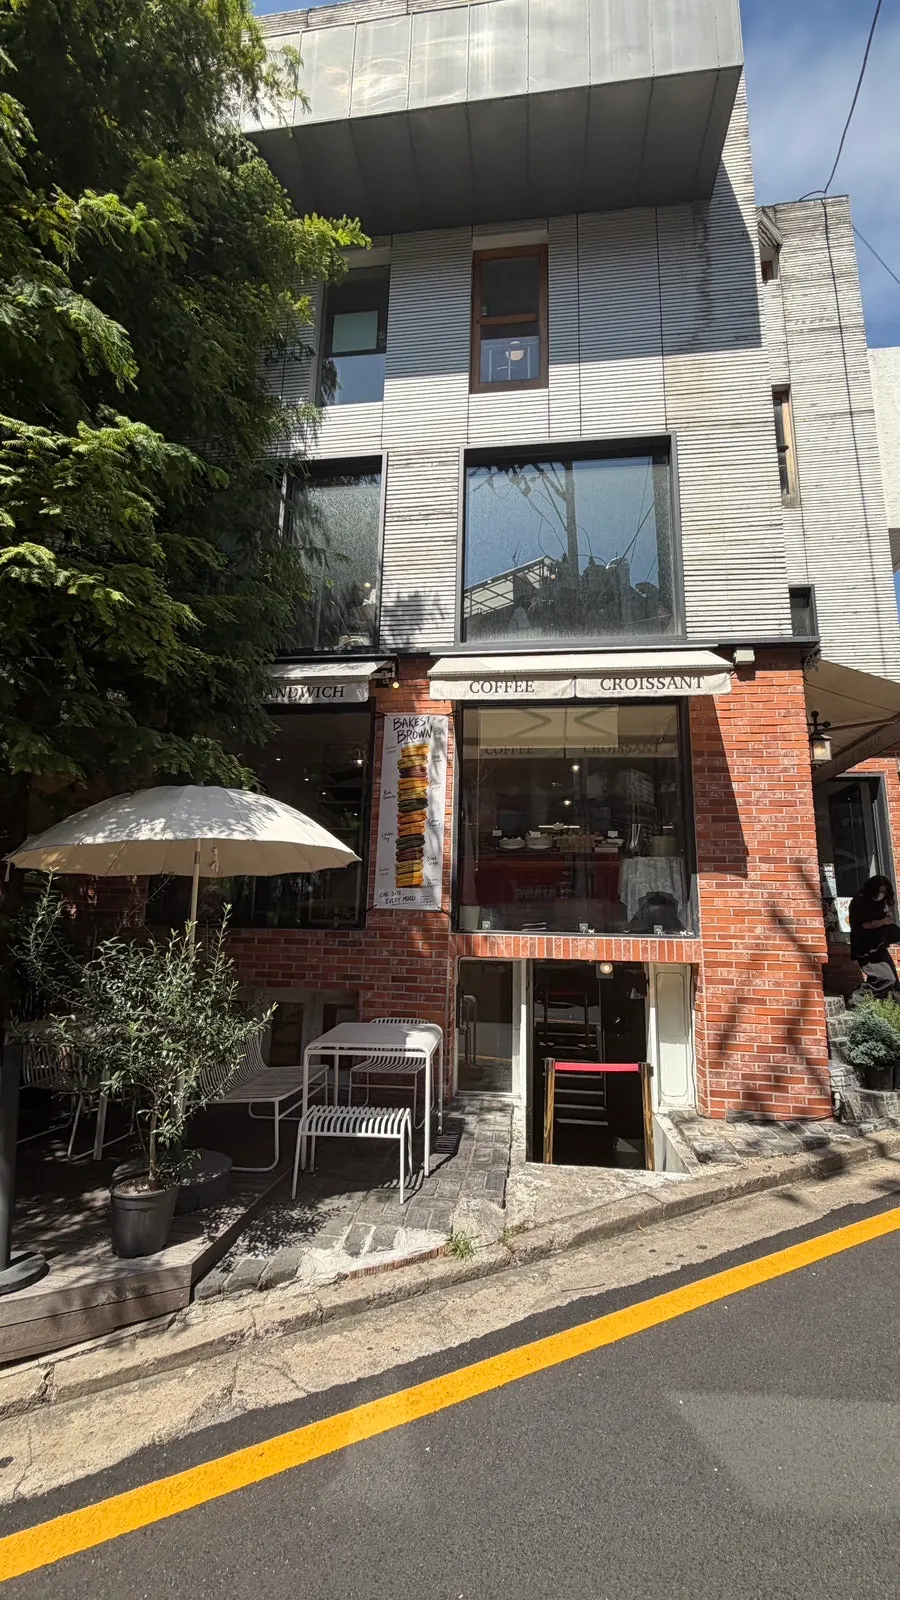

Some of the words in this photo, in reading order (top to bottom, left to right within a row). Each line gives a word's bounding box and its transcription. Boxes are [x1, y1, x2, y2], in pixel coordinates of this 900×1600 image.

[469, 680, 535, 694] COFFEE
[600, 676, 705, 691] CROISSANT
[393, 716, 430, 731] BAKEST
[397, 726, 432, 743] BROWN
